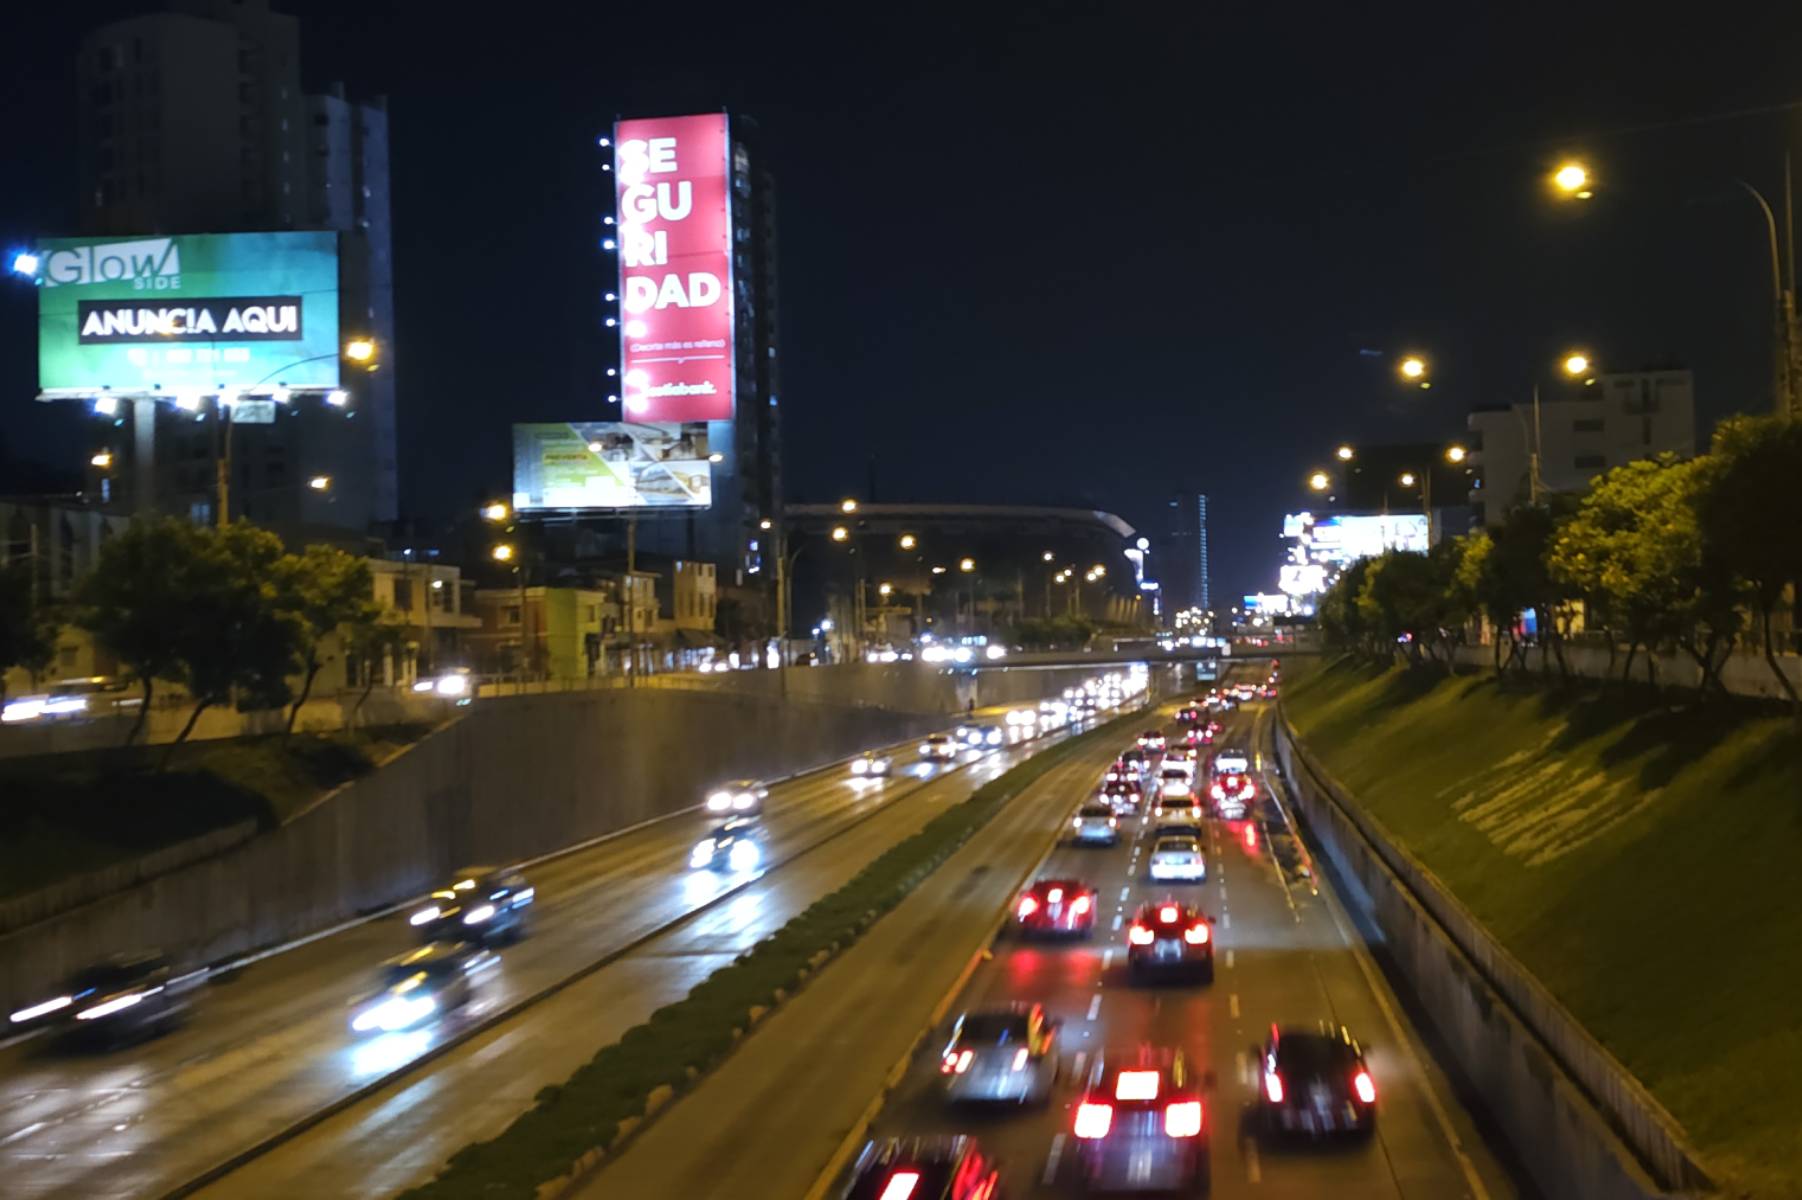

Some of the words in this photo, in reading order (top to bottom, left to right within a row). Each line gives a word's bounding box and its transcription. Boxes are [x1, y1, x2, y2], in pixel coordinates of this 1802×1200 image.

[619, 138, 678, 174] SE
[622, 181, 692, 224] GU
[625, 231, 668, 267] RI
[133, 276, 181, 290] SIDE
[625, 272, 721, 310] DAD
[81, 306, 217, 336] ANUNCIA
[222, 305, 298, 334] AQUI
